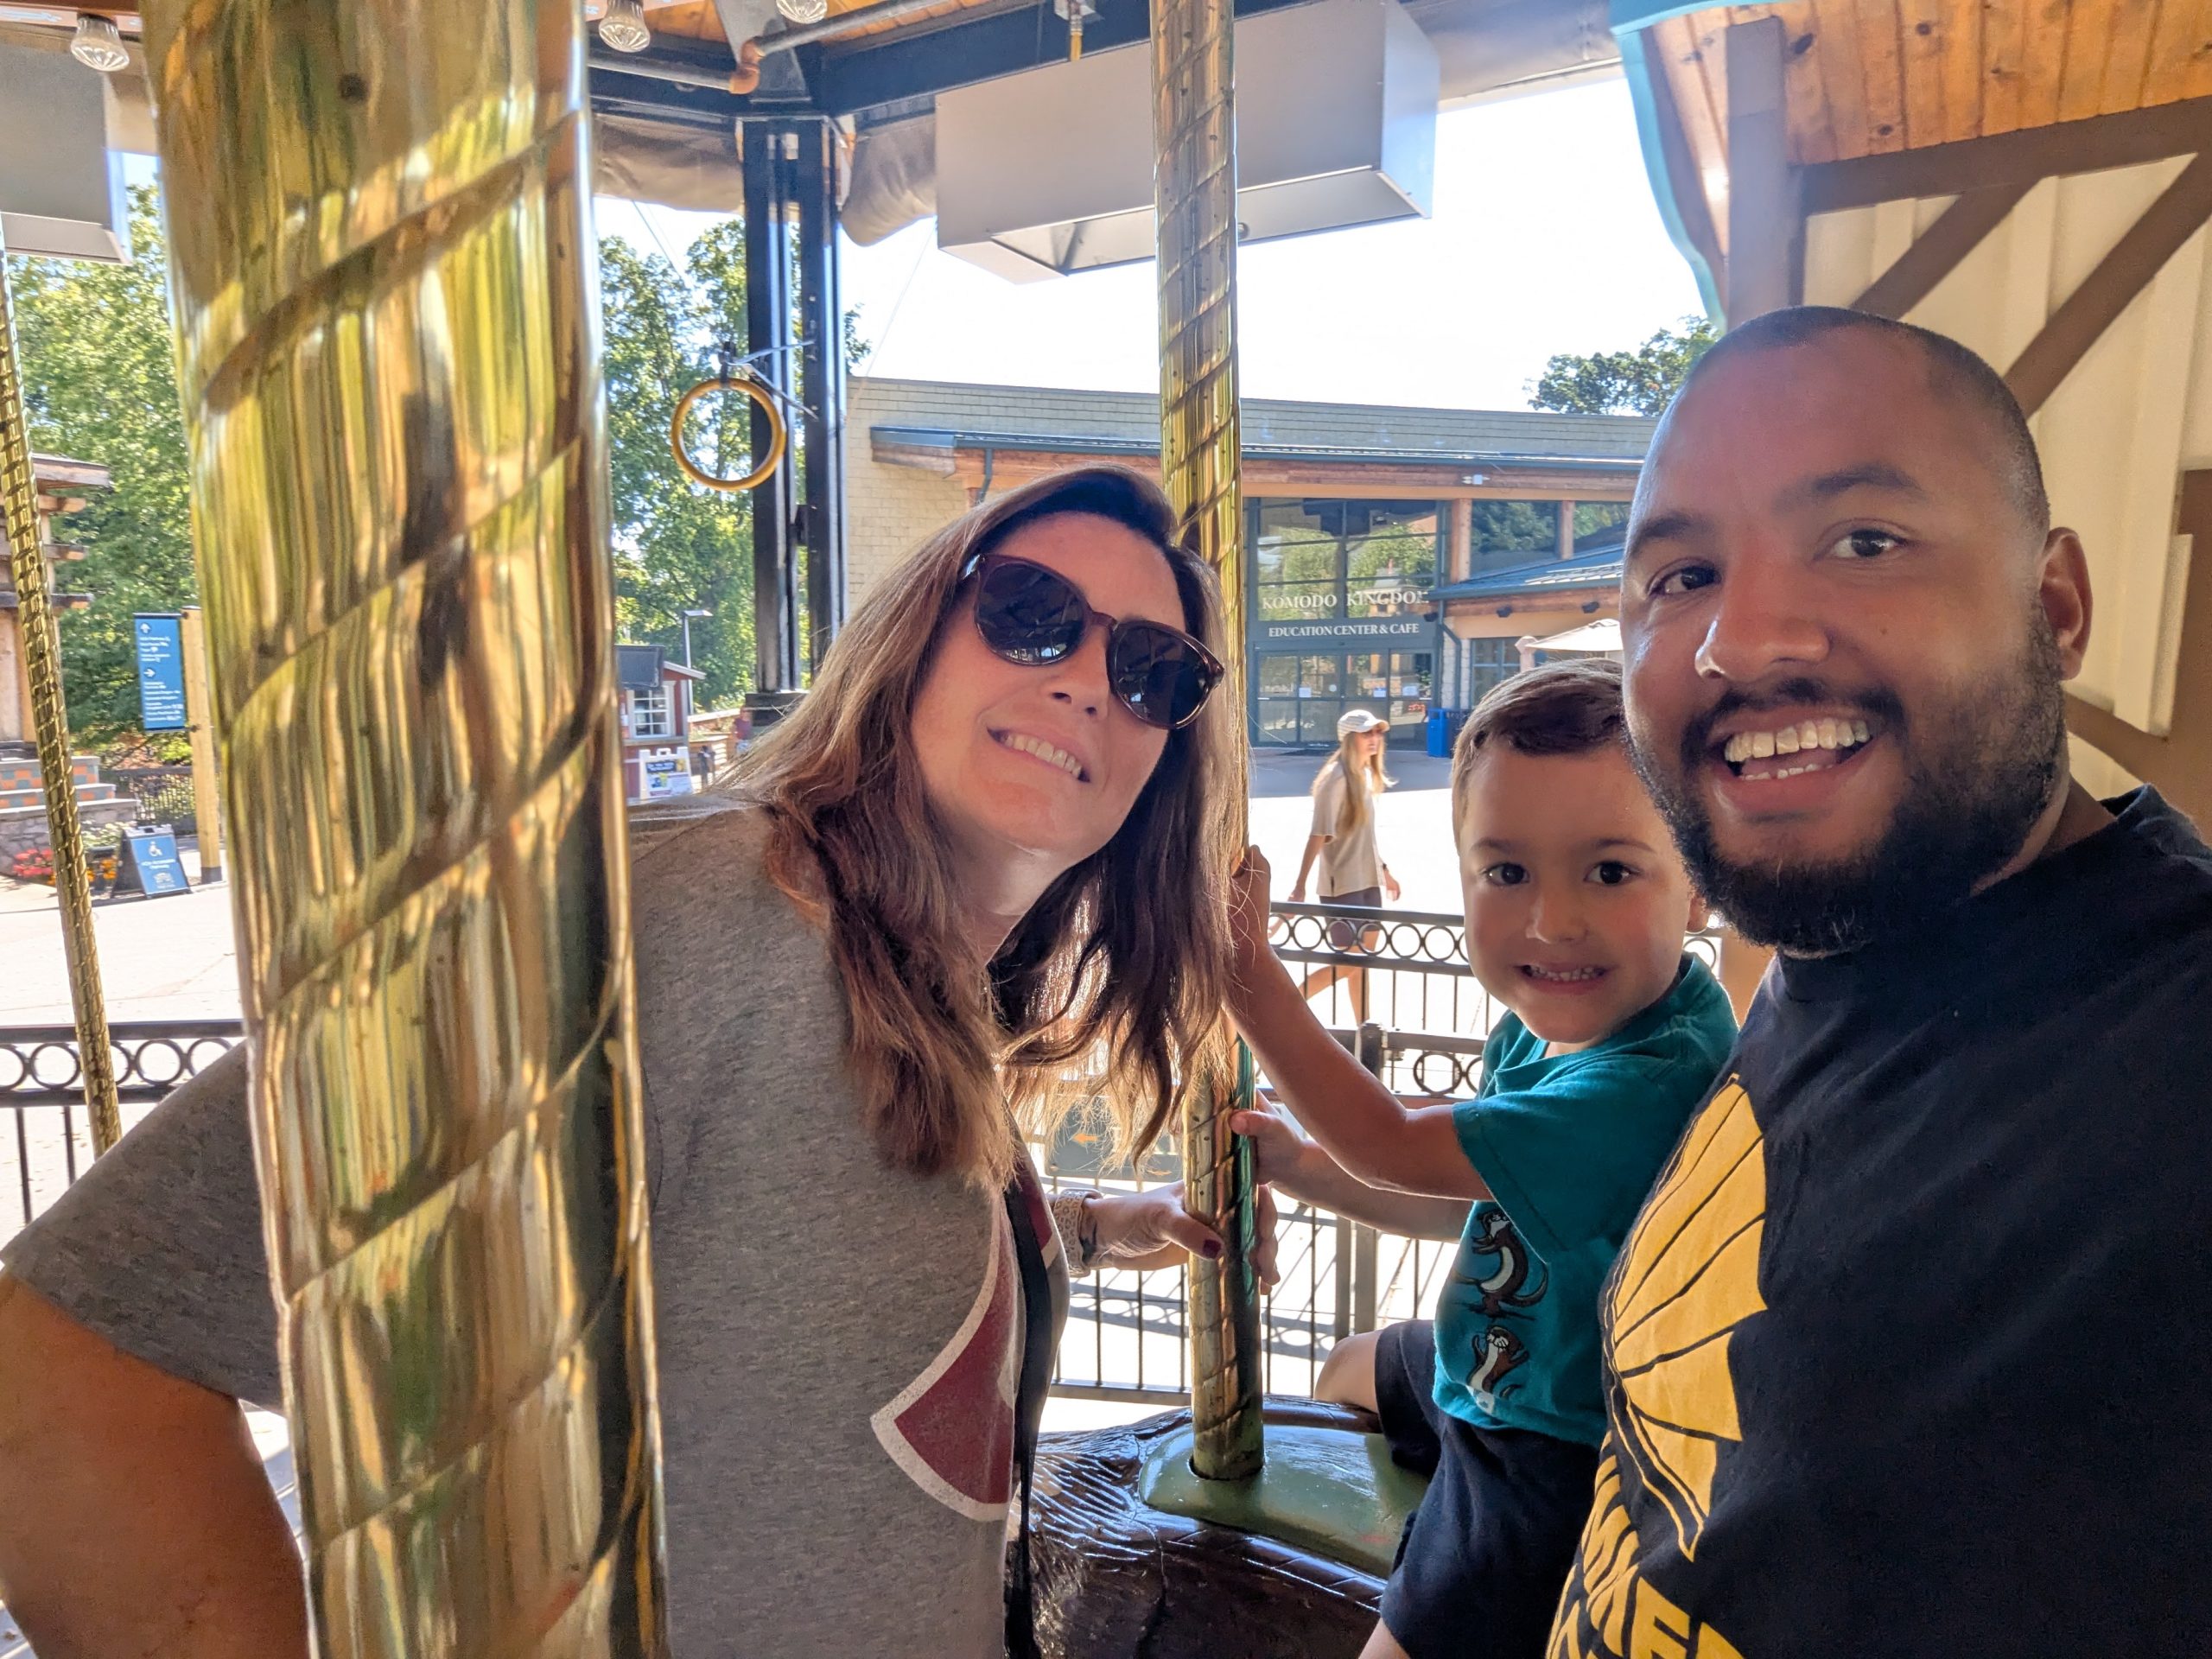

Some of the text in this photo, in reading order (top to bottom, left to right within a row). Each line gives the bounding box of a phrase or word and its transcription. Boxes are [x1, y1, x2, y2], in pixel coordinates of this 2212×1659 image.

[1262, 594, 1338, 610] KOMODO
[1268, 623, 1420, 638] EDUCATION CENTER & CAFE
